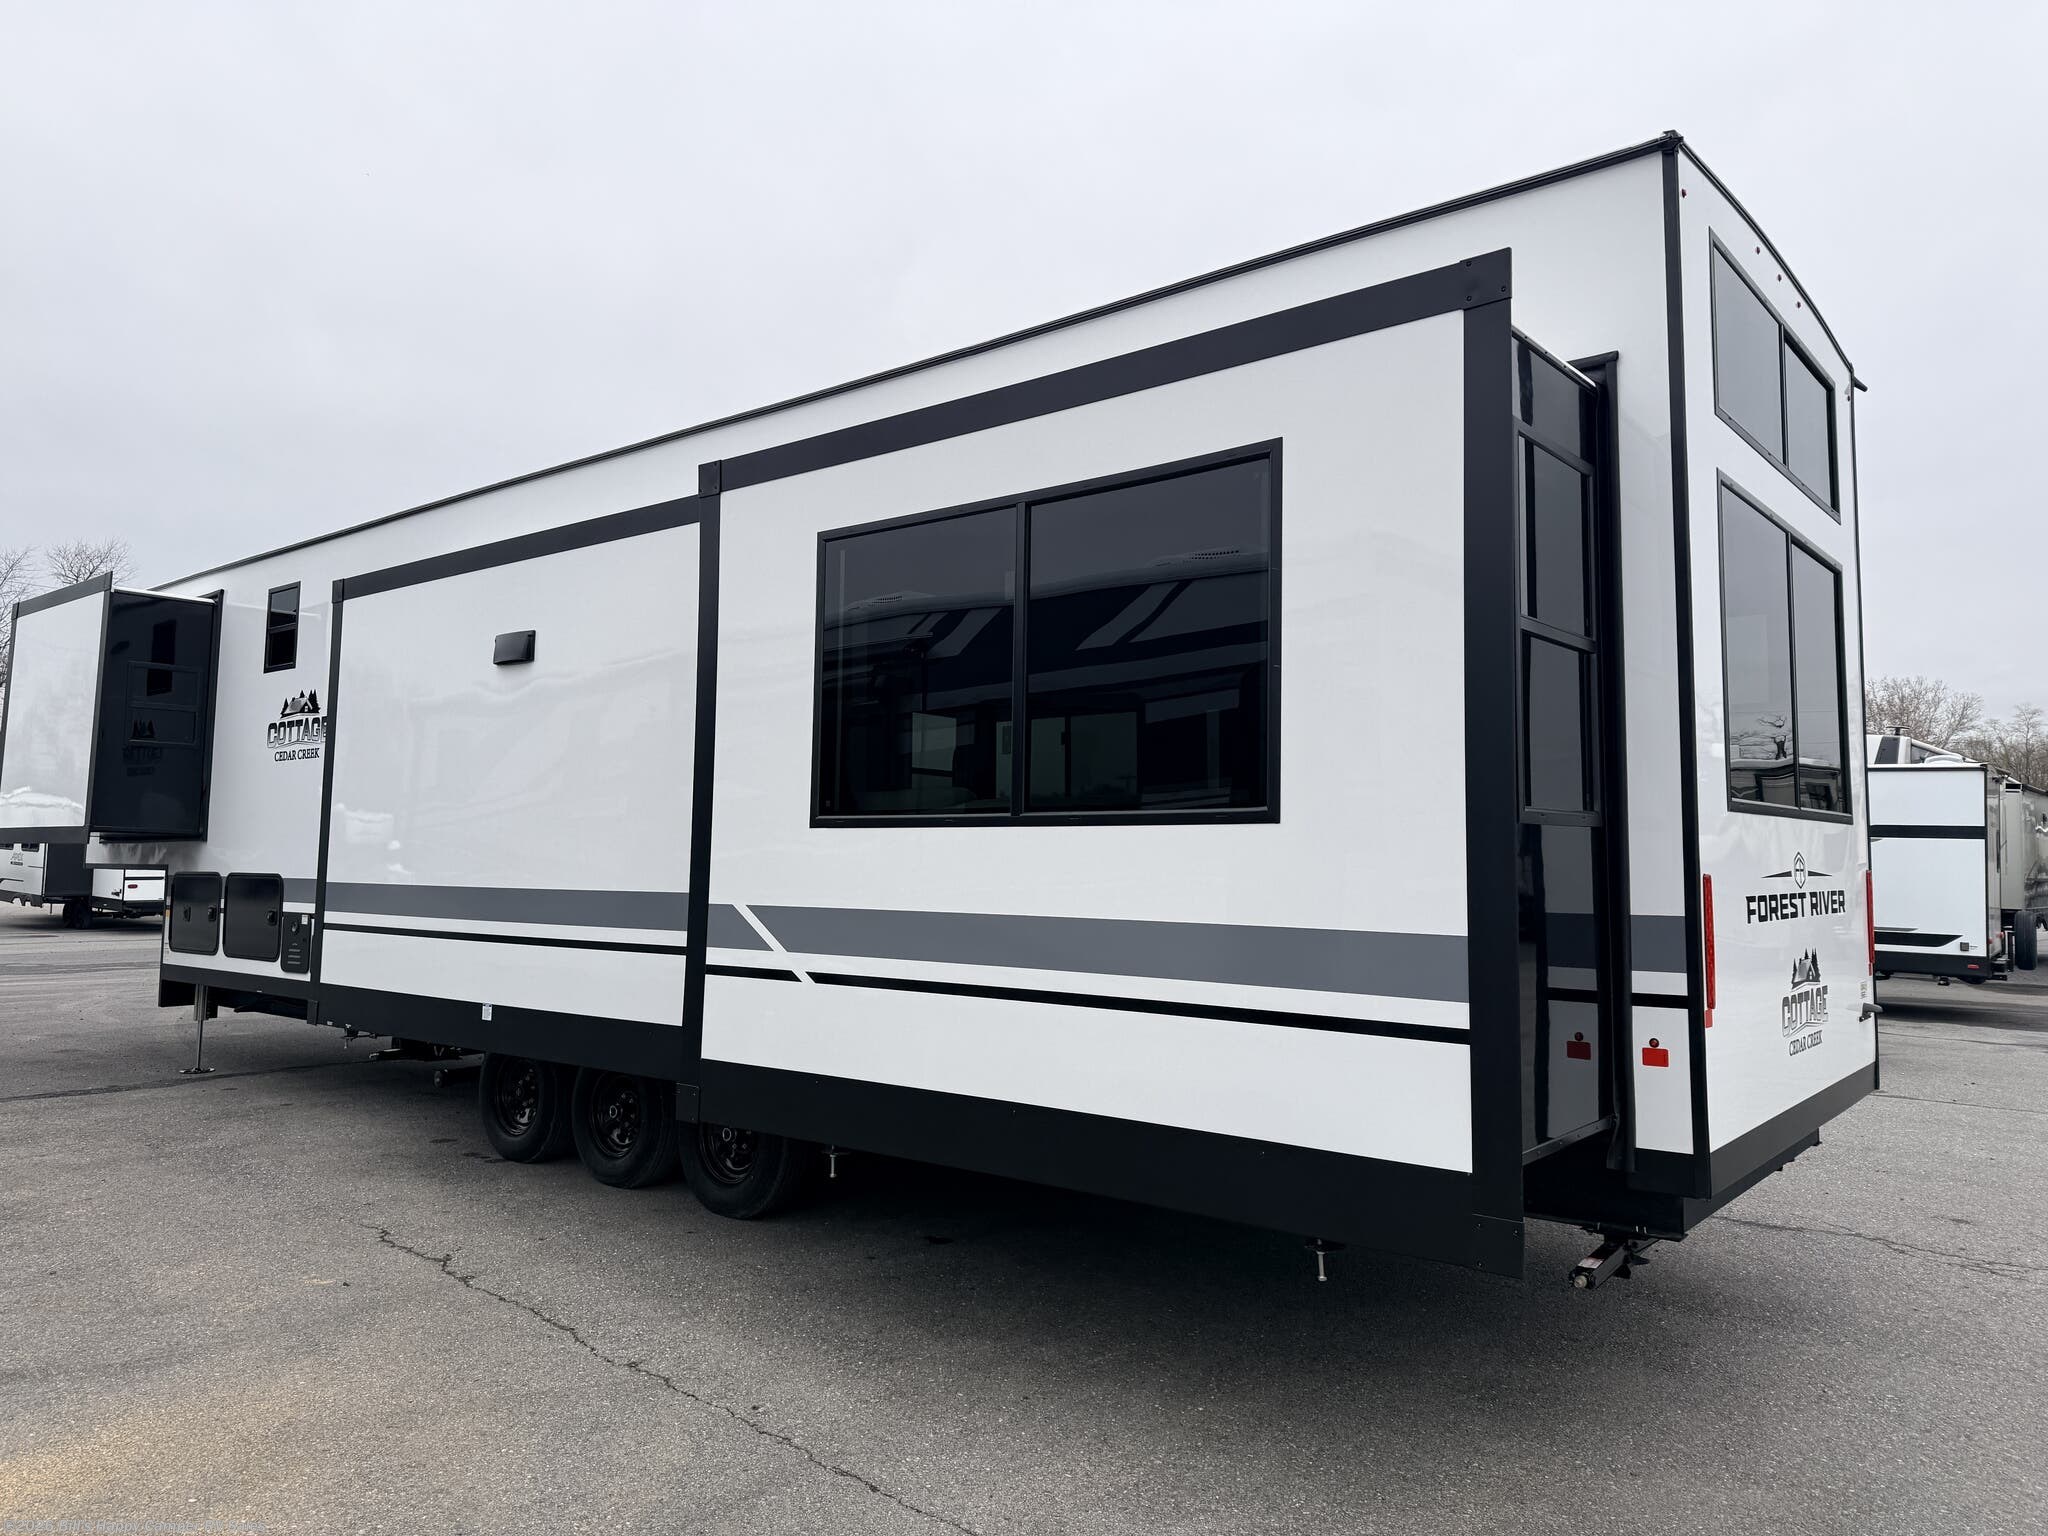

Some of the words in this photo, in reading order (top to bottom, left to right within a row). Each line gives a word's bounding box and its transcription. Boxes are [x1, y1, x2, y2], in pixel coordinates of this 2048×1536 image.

[267, 715, 328, 748] COTTAGE
[274, 750, 297, 762] CEDAR
[297, 748, 320, 760] CREEK
[1746, 892, 1807, 924] FOREST
[1809, 889, 1846, 916] RIVER
[1781, 985, 1829, 1038] COTTAGE
[1789, 1036, 1807, 1056] CEDAR
[1807, 1030, 1823, 1050] CREEK
